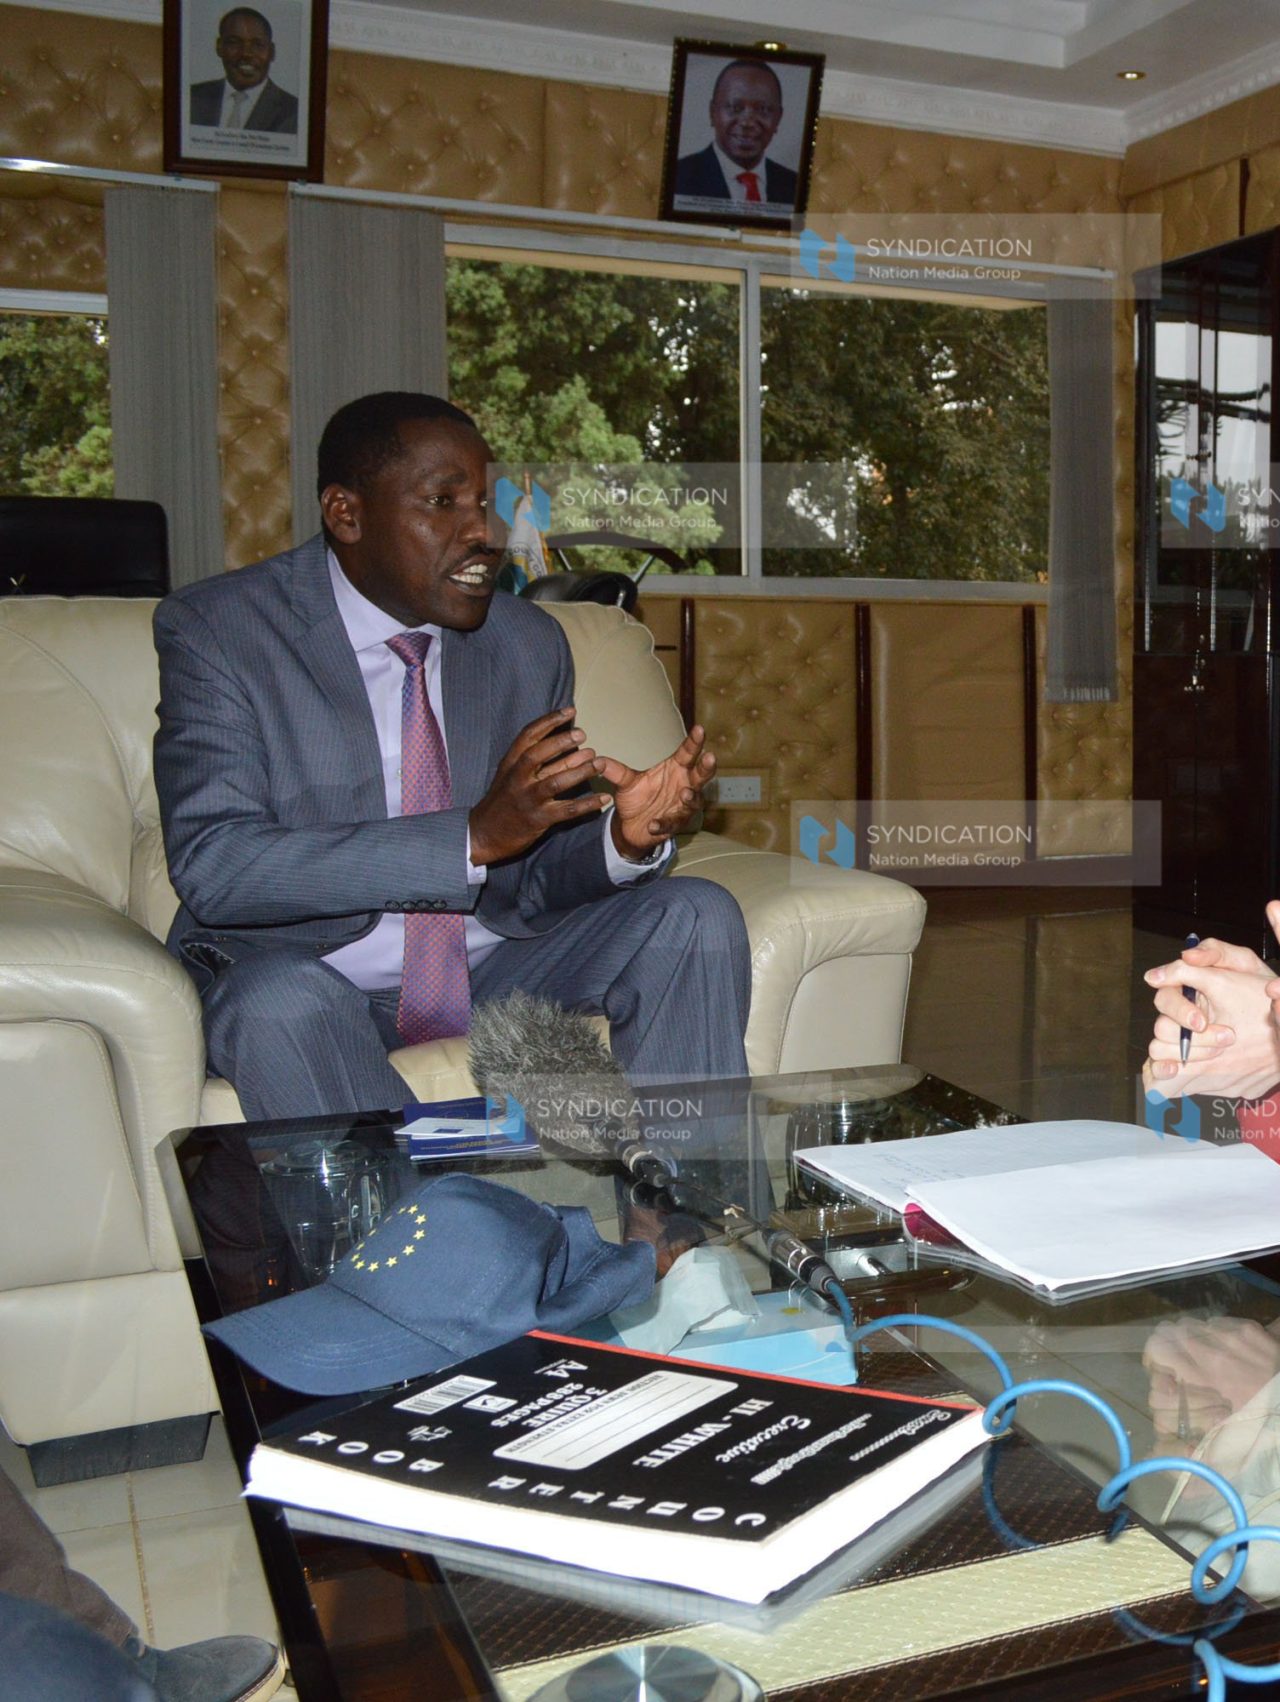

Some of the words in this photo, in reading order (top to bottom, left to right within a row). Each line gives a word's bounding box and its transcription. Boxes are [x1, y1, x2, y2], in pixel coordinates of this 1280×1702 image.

[543, 1360, 588, 1378] A4
[521, 1393, 593, 1428] QUIRE
[586, 1387, 608, 1397] 3
[736, 1398, 775, 1416] HI
[297, 1430, 446, 1473] BOOK
[632, 1421, 733, 1468] WHITE
[715, 1414, 812, 1464] Executive
[487, 1475, 768, 1527] COUNTER
